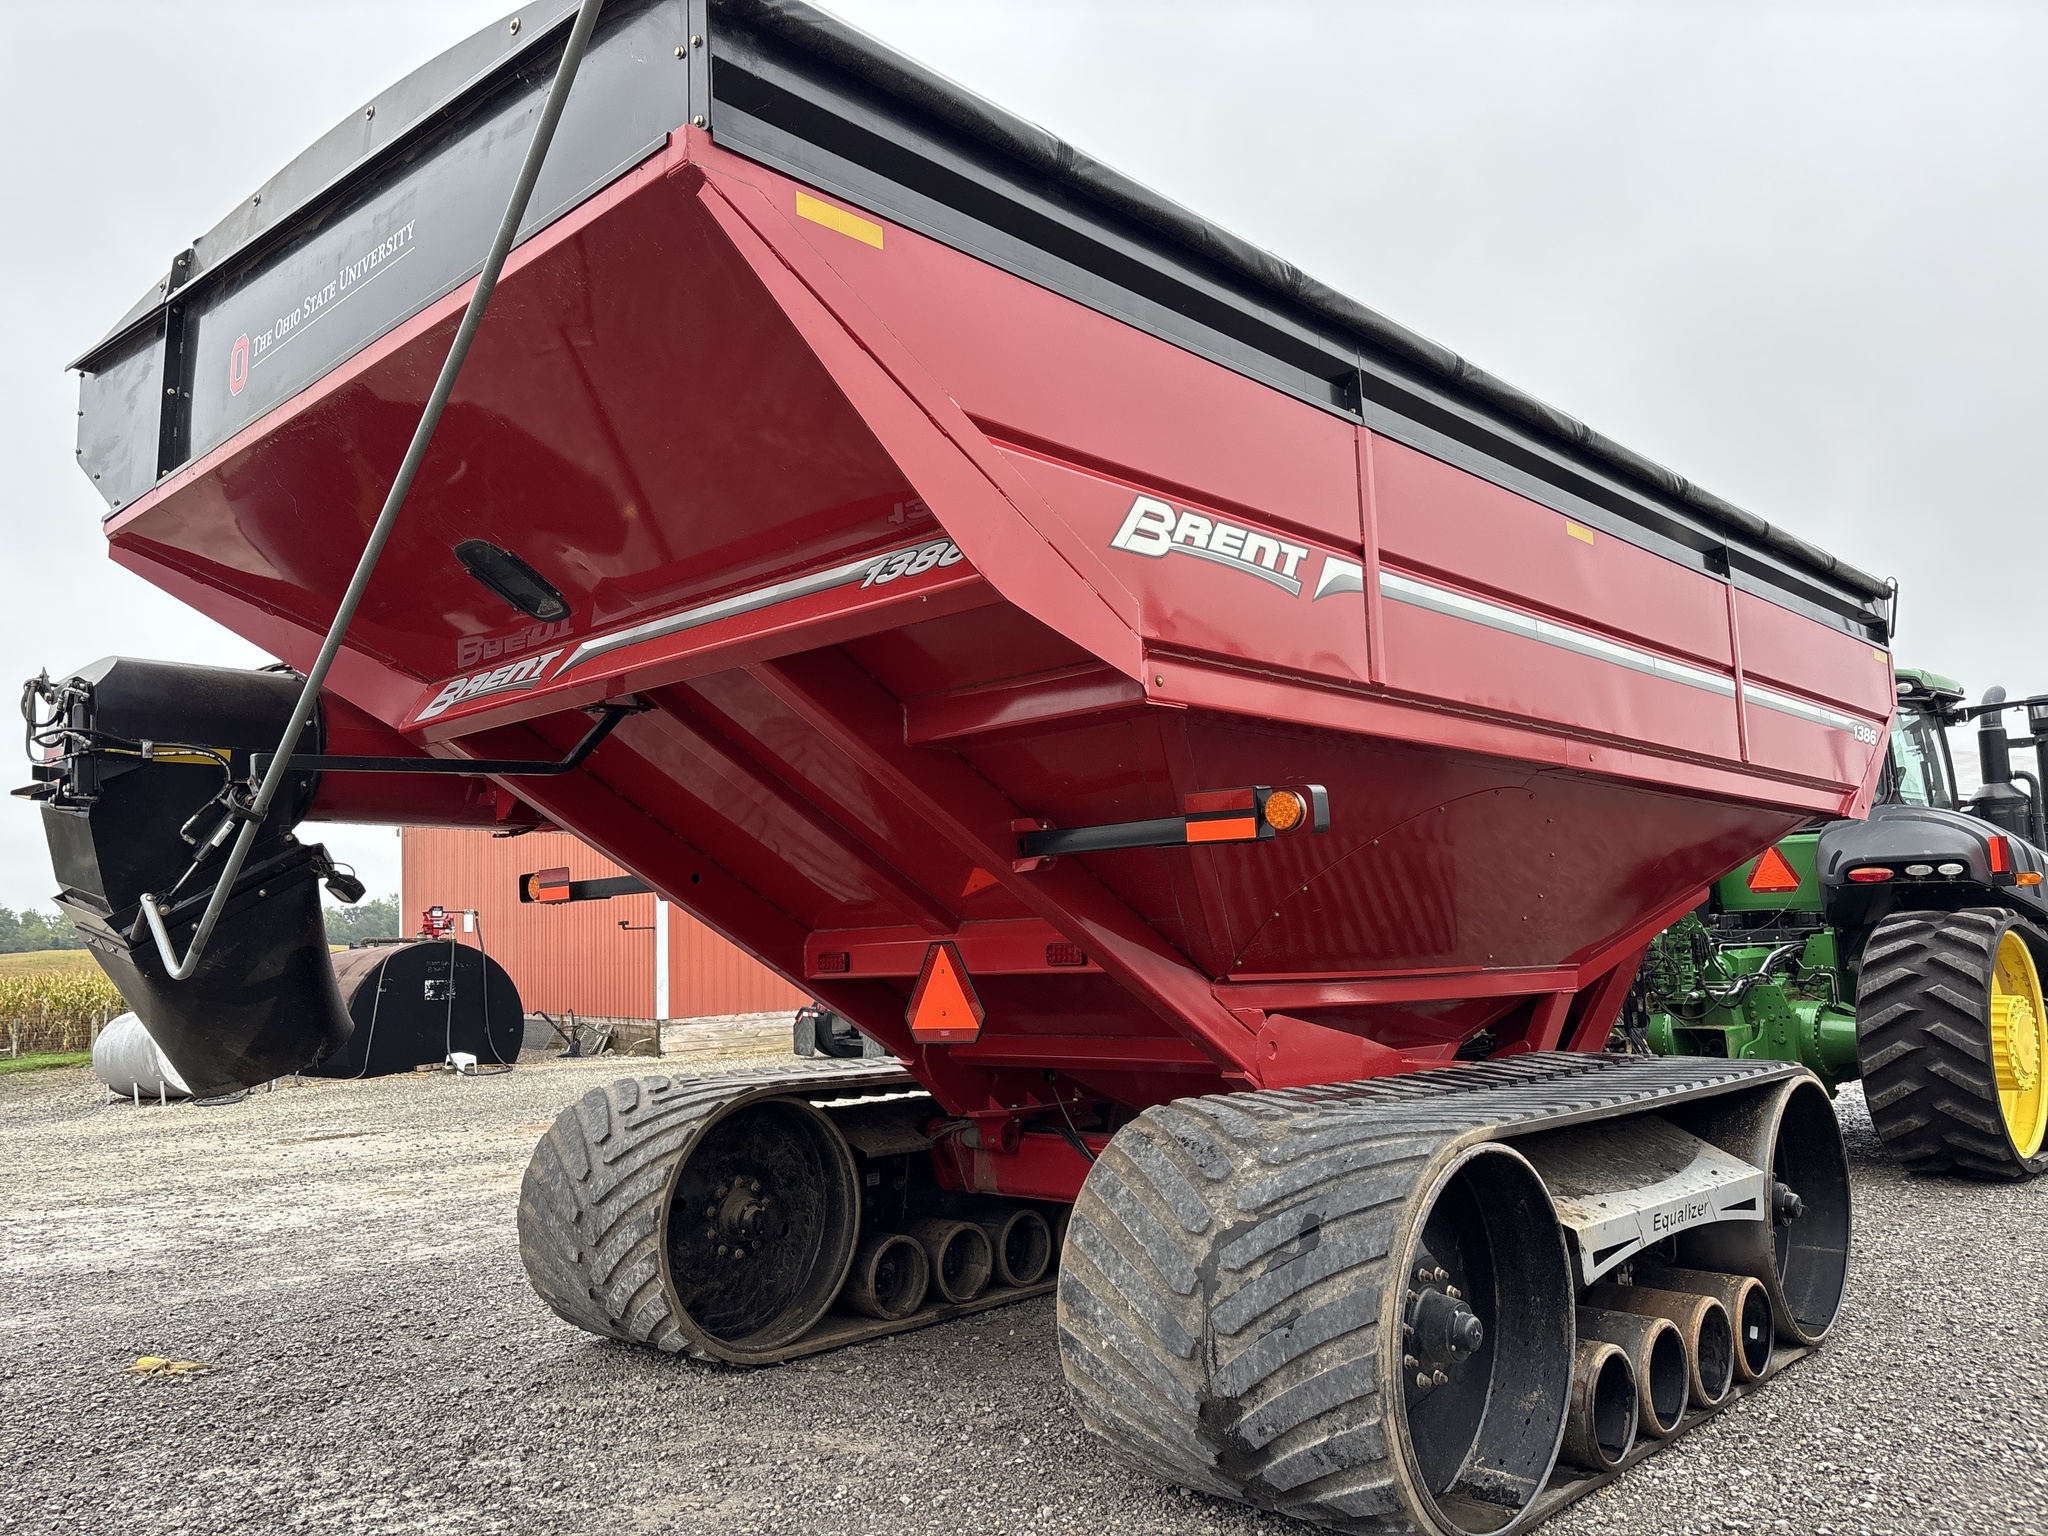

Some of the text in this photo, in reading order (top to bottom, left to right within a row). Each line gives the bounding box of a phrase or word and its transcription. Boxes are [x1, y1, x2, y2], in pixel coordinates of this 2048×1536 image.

[230, 333, 249, 396] O
[1109, 494, 1309, 579] BRENT
[413, 648, 566, 723] BRENT
[1853, 724, 1877, 745] 1386
[1653, 1202, 1709, 1232] Equalizer
